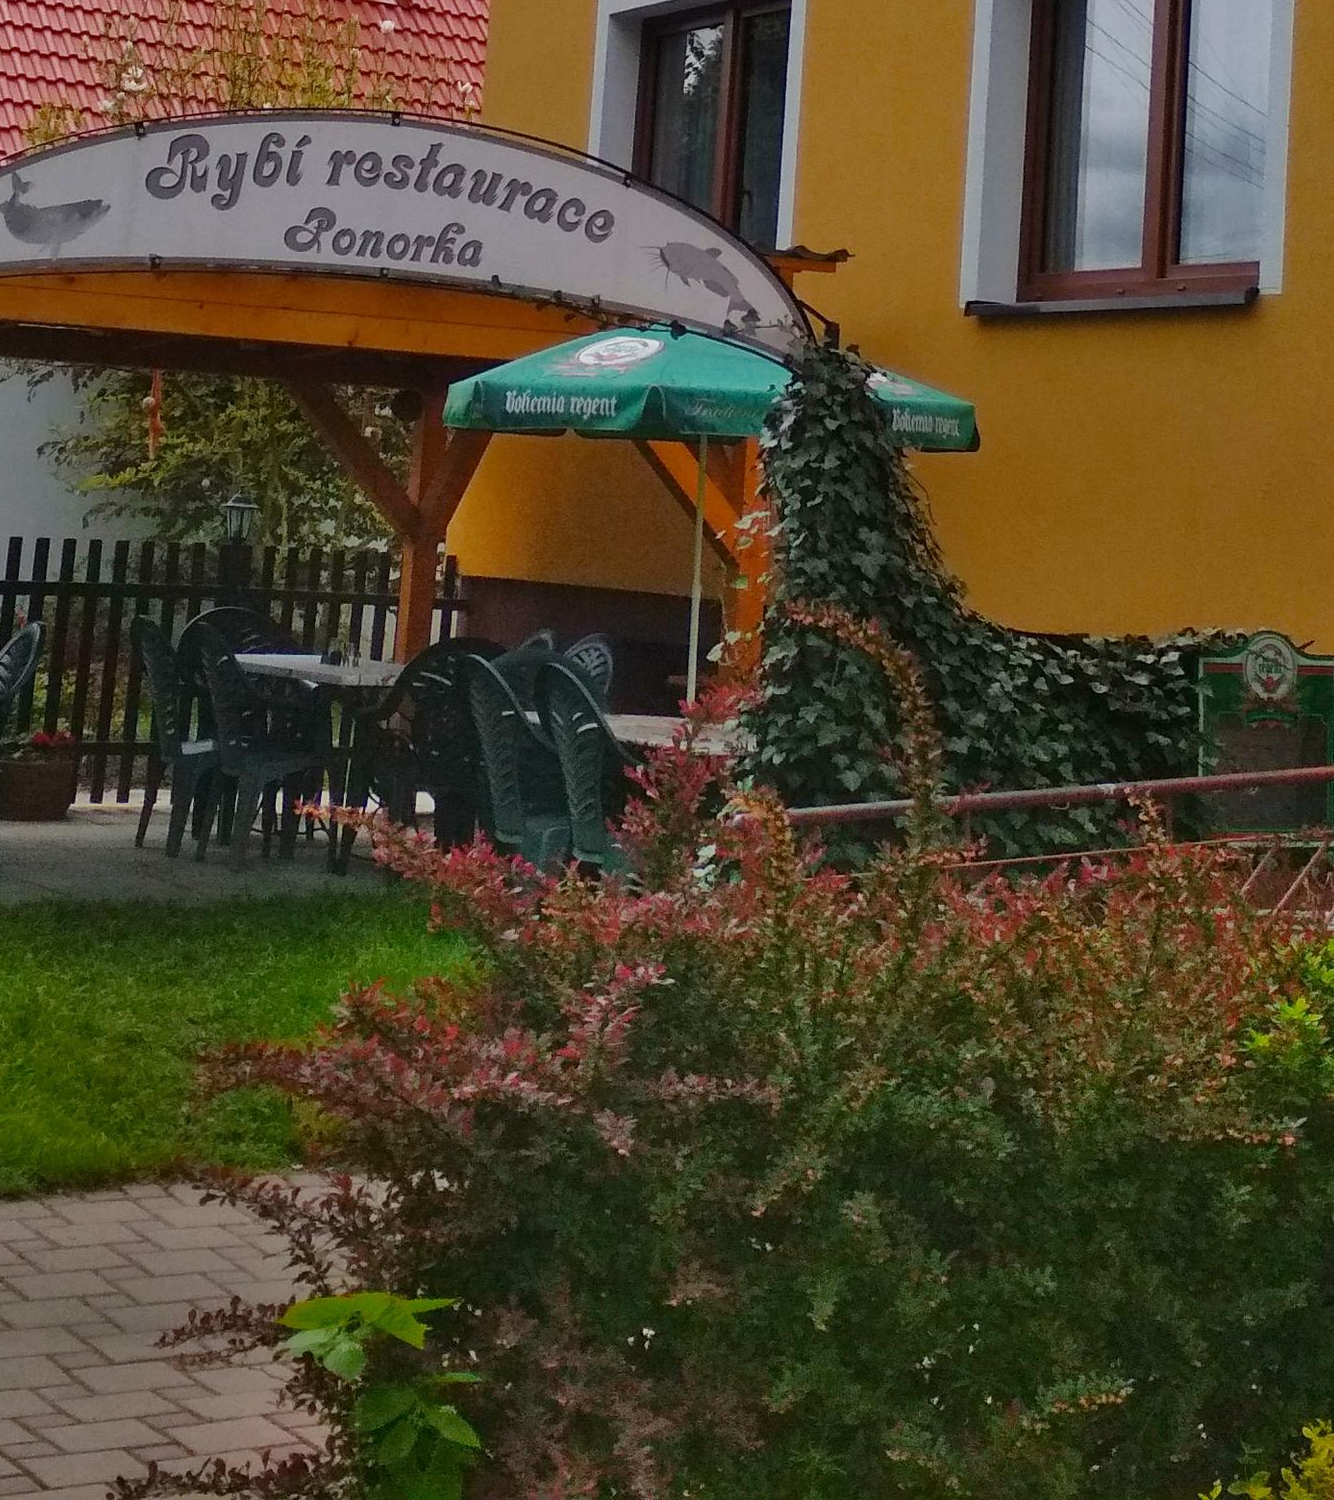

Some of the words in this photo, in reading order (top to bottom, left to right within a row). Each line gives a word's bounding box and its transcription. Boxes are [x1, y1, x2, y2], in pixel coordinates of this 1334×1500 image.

[145, 131, 314, 211] Rybí
[325, 142, 615, 245] restaurace
[283, 206, 483, 268] Ponorka
[505, 389, 565, 415] Bohemia
[570, 393, 617, 420] regent
